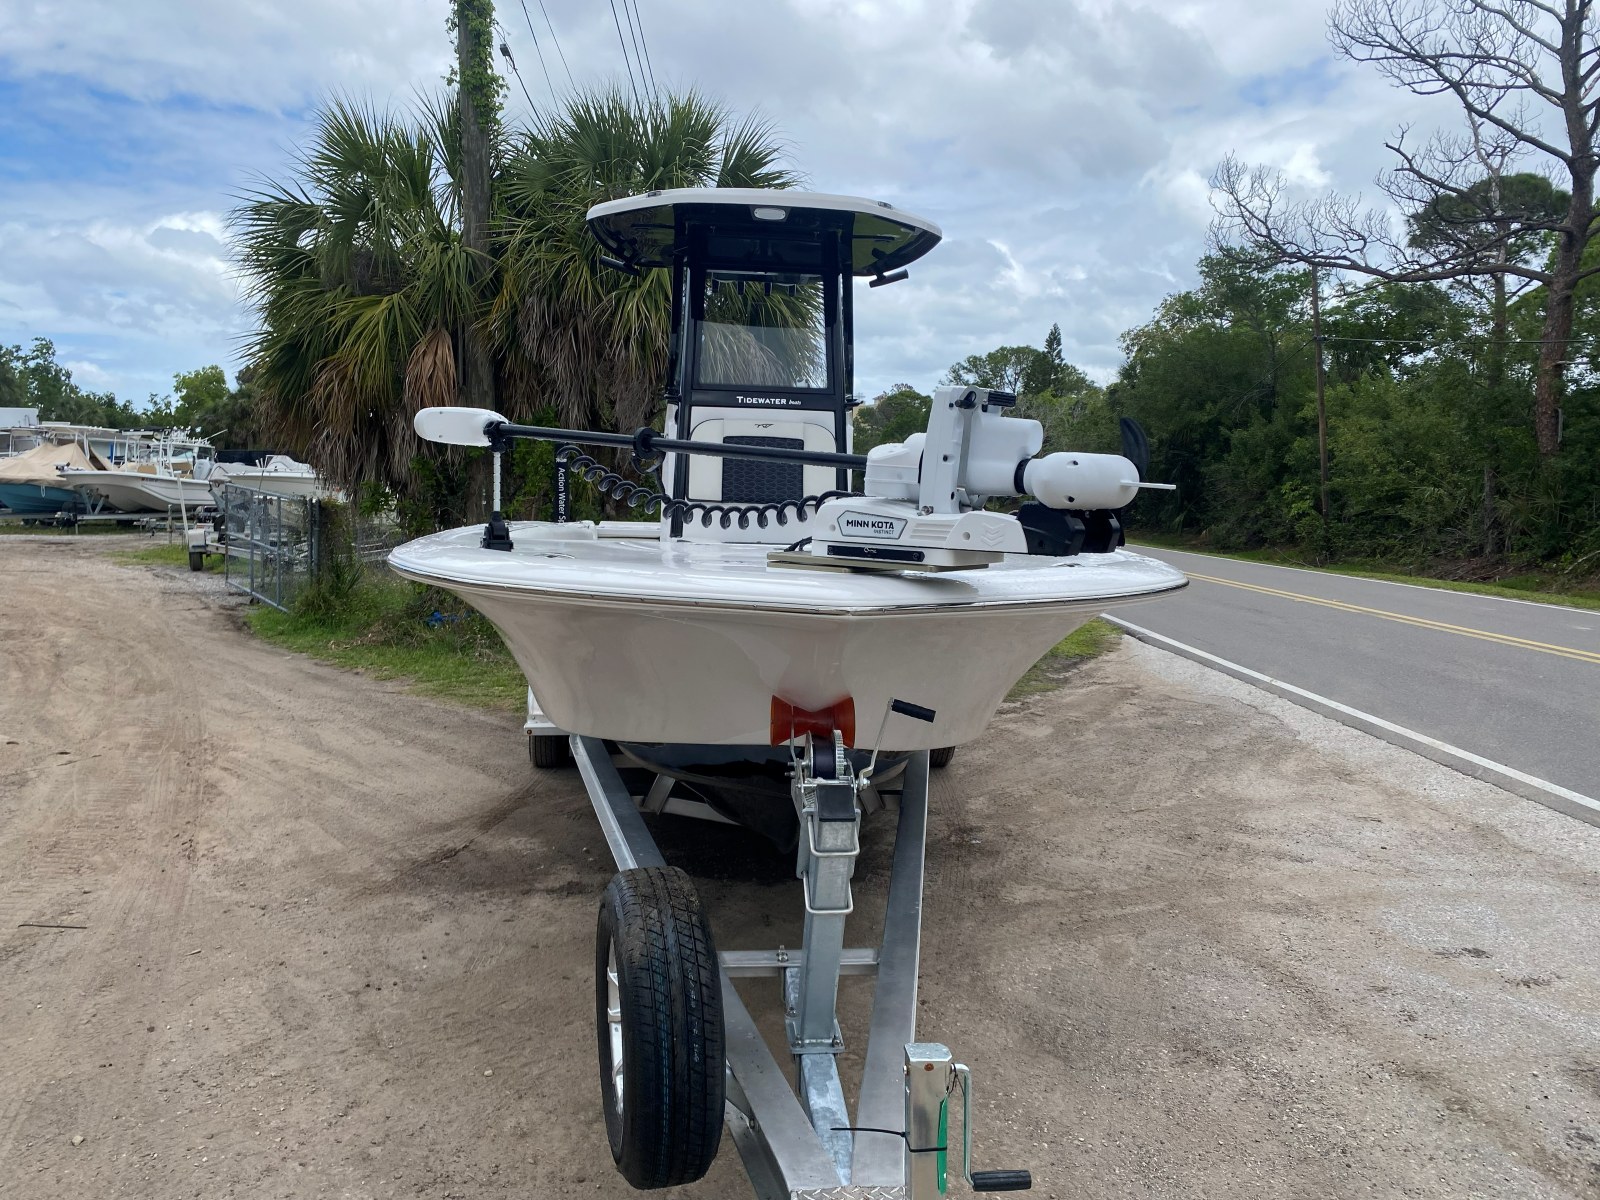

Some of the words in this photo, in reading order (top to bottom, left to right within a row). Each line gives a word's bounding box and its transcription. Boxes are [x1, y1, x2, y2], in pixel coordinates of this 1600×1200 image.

[736, 396, 787, 405] TIDEWATER
[558, 467, 566, 492] Action
[558, 492, 566, 515] Water
[846, 519, 870, 528] MINN
[871, 520, 895, 529] KOTA
